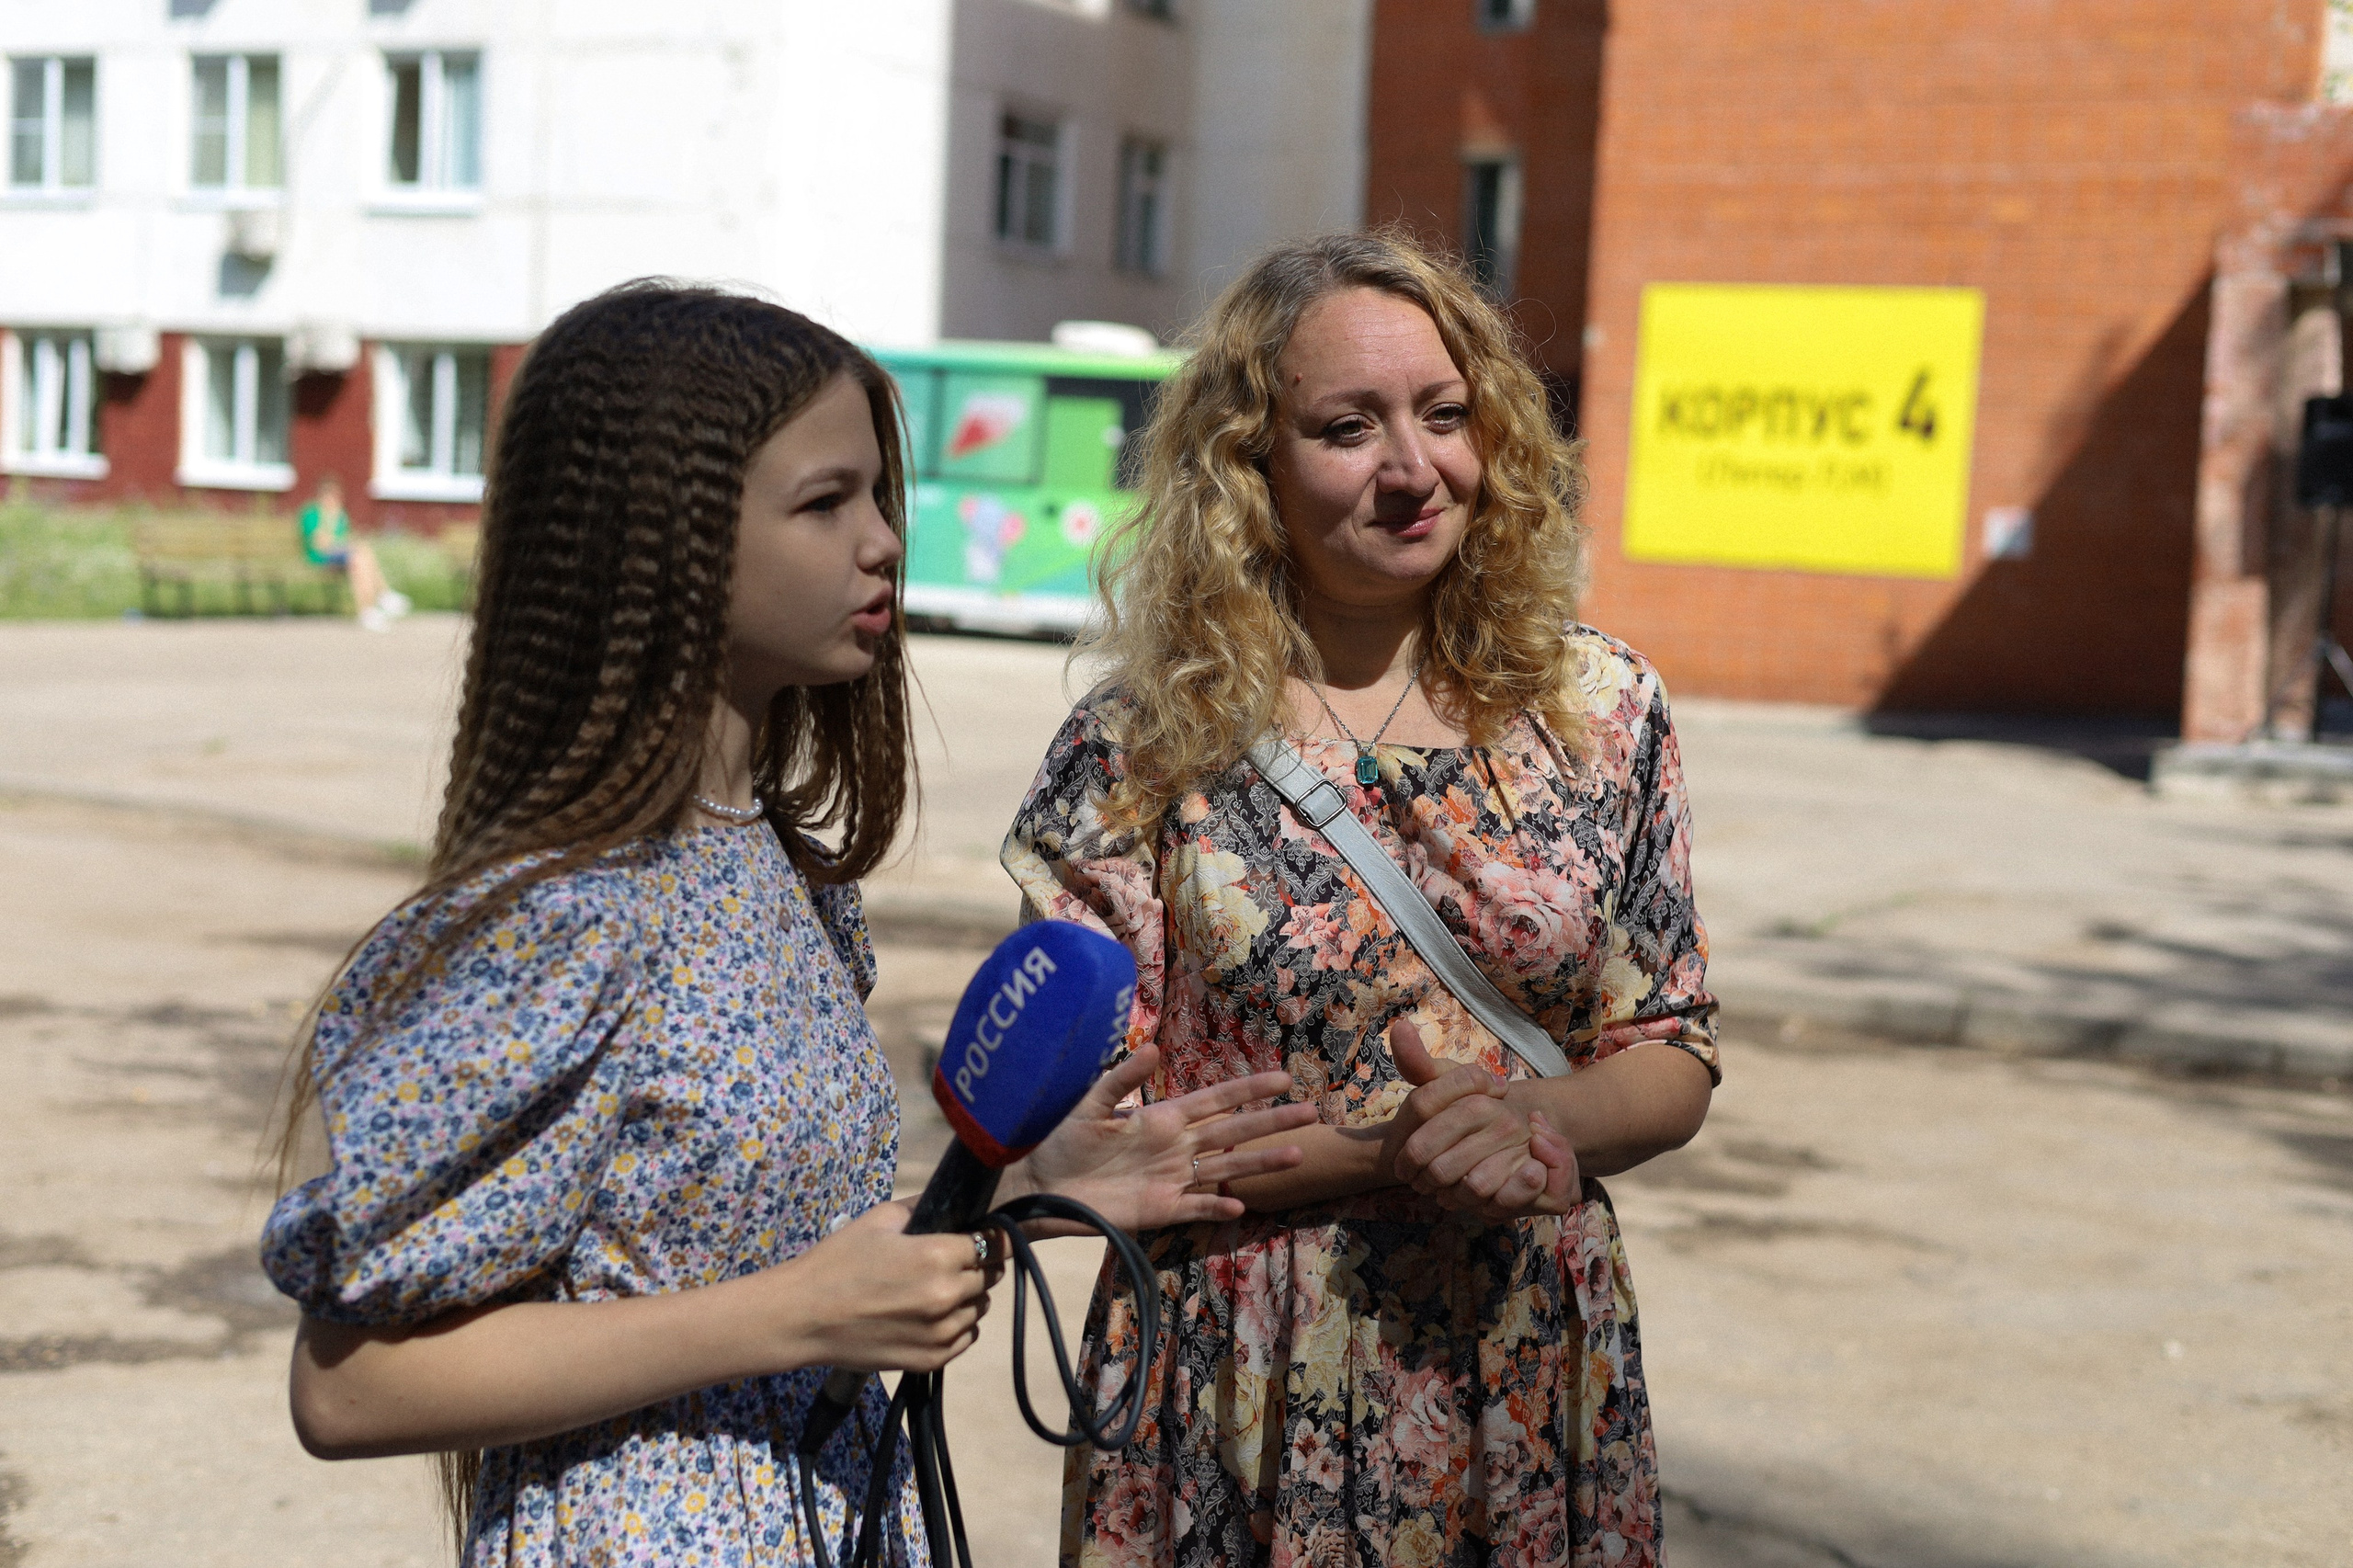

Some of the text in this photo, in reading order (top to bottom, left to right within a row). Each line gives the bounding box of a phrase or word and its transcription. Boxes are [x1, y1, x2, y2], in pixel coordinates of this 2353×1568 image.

[1657, 363, 1938, 445] КОРПУС 4
[954, 946, 1057, 1104] РОССИЯ
